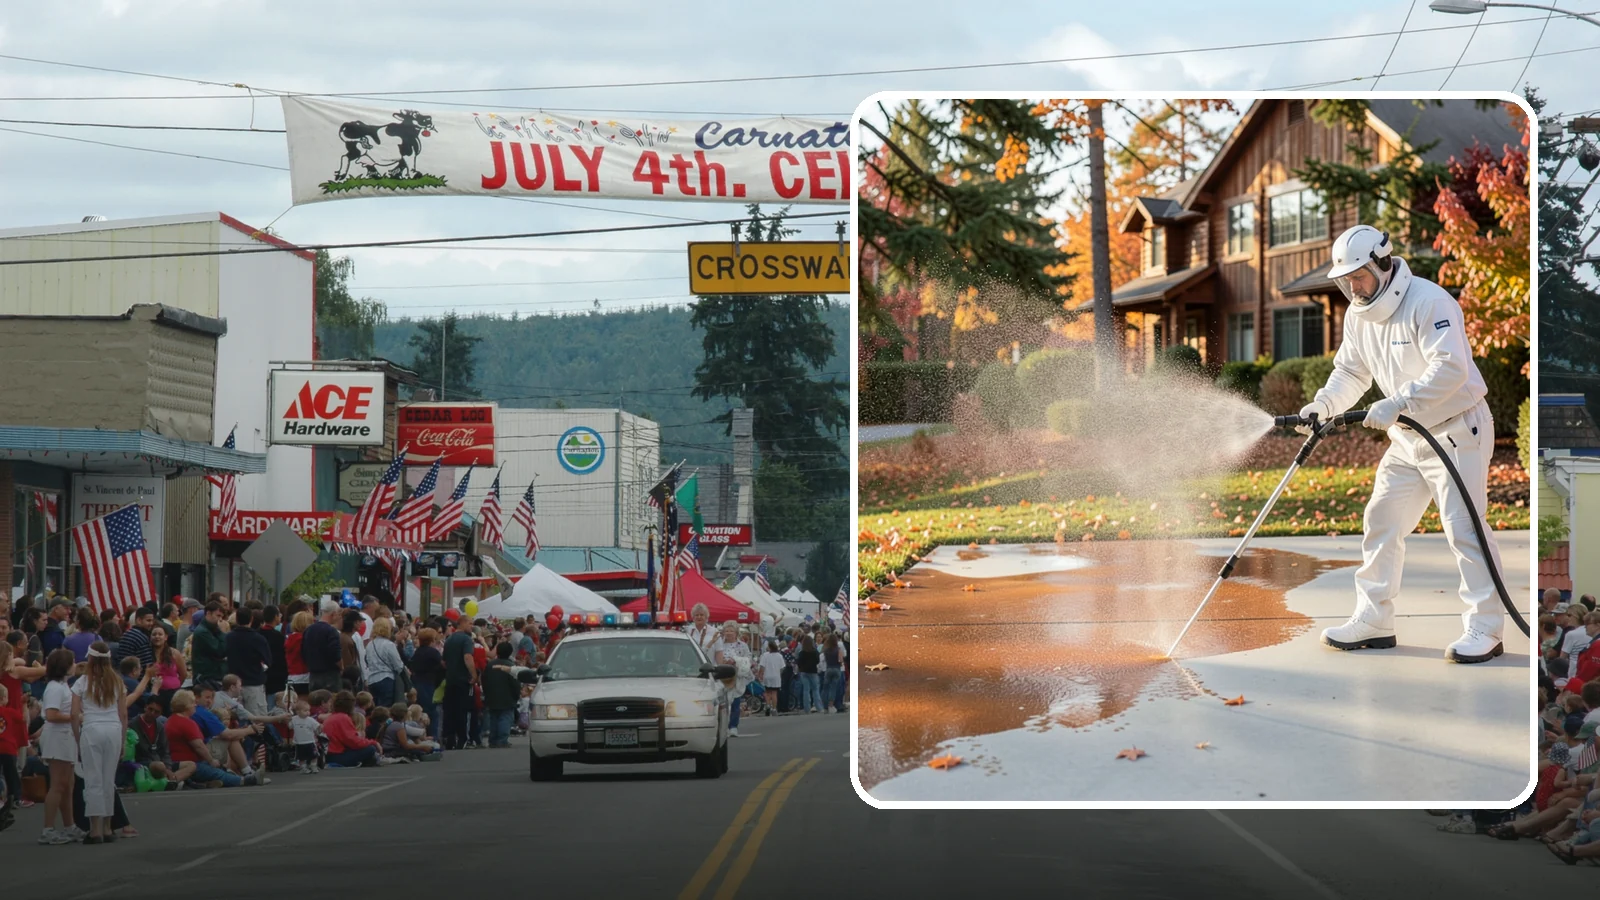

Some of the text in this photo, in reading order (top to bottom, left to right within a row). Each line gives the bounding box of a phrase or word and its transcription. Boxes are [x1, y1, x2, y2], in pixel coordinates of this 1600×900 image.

[694, 121, 850, 150] Carnat
[481, 140, 605, 192] JULY
[632, 150, 746, 198] 4th.
[696, 254, 850, 280] CROSSWA
[282, 380, 374, 420] ACE
[405, 409, 485, 422] CEDAR LOG
[283, 421, 371, 436] Hardware
[416, 428, 477, 447] Coca-Cola
[353, 467, 386, 480] Simpl
[95, 485, 124, 495] Vincent
[125, 485, 136, 494] de
[137, 486, 155, 495] Paul
[212, 515, 331, 536] HARDARE
[688, 526, 742, 535] CRNATION
[699, 535, 730, 543] GLASS
